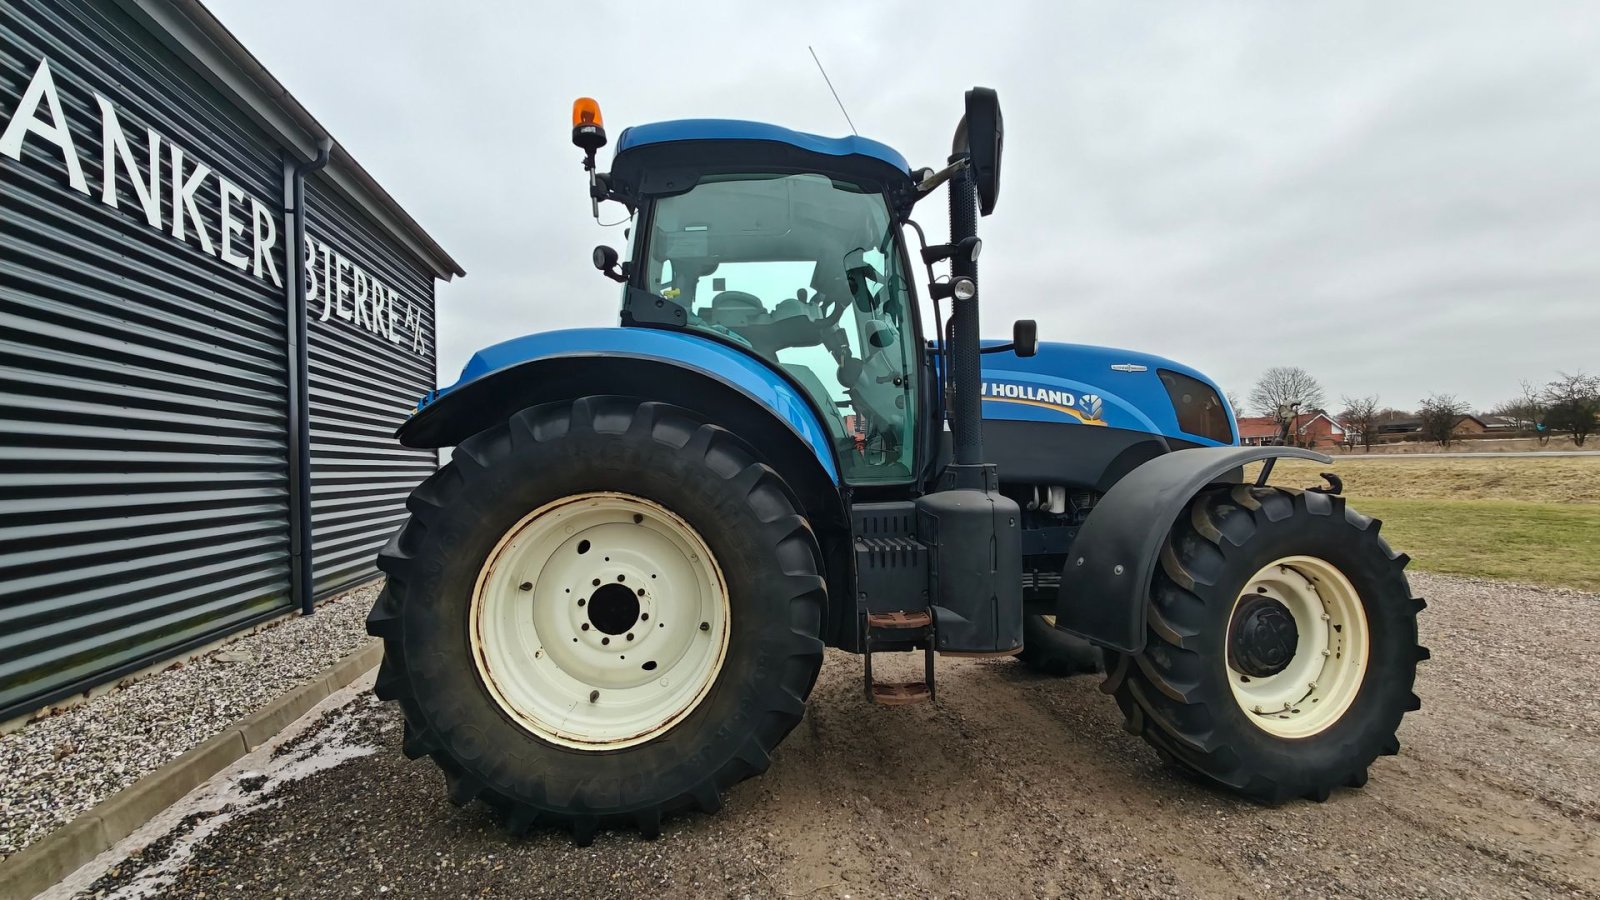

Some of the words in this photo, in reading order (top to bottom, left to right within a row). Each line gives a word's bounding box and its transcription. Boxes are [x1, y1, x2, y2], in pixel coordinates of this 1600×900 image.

[0, 57, 283, 288] ANKER
[404, 299, 425, 355] A/S
[991, 382, 1075, 407] HOLLAND
